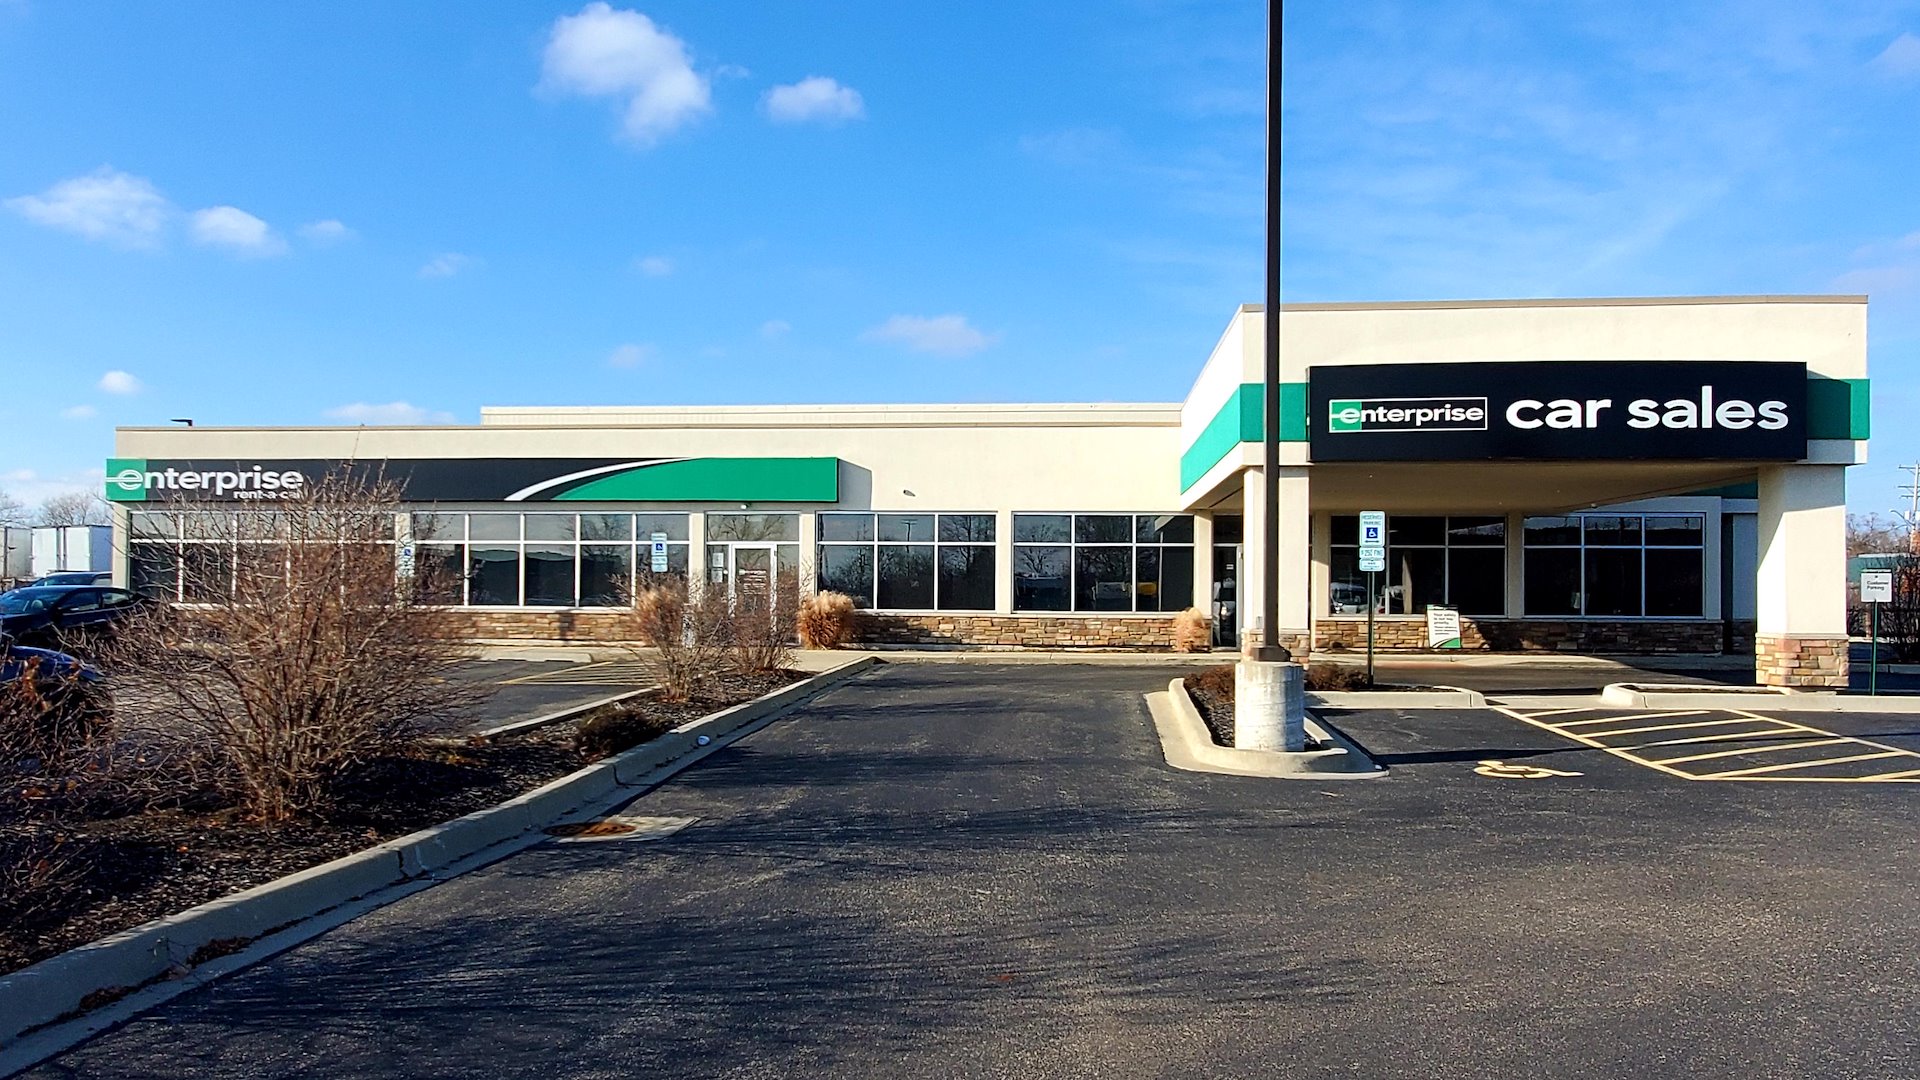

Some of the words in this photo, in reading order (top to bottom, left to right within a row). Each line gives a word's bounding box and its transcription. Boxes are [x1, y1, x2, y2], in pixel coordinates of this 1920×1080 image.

[1332, 404, 1484, 427] enterprise
[1505, 396, 1612, 430] car
[1627, 385, 1789, 430] sales
[106, 465, 304, 496] enterprise
